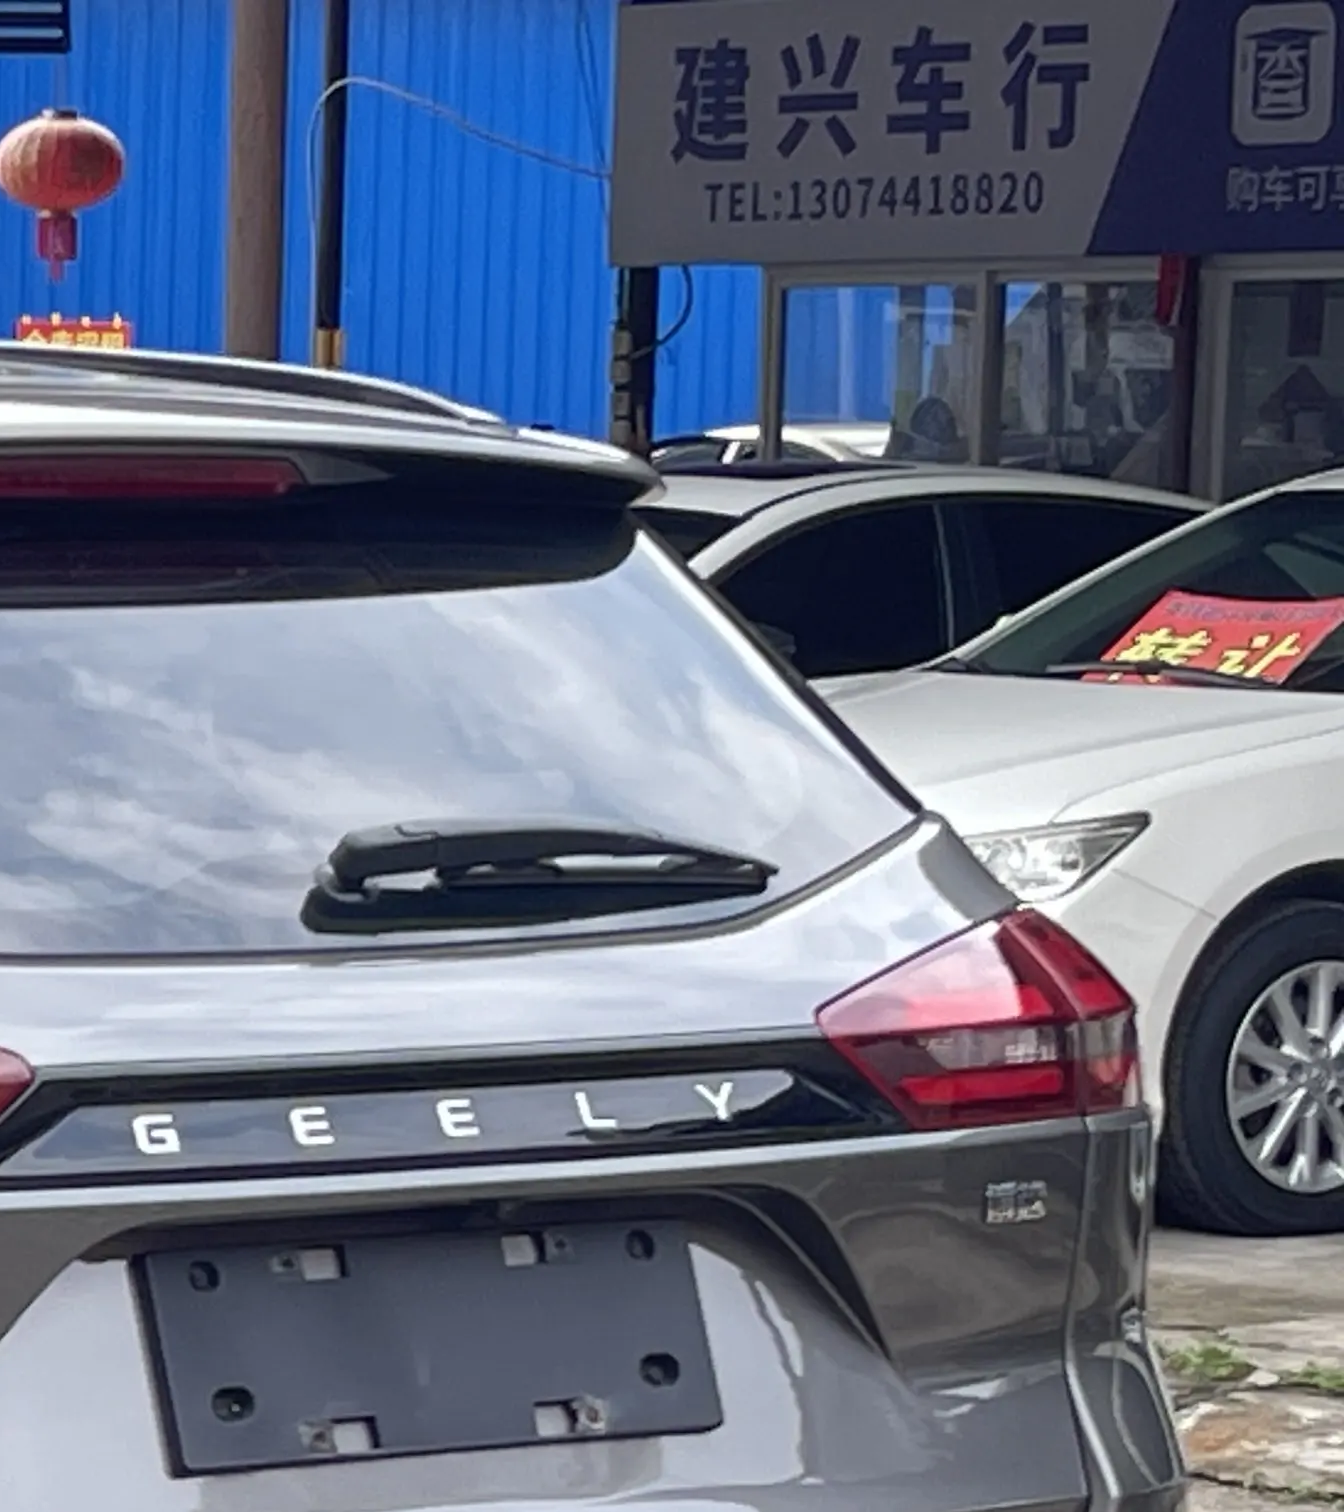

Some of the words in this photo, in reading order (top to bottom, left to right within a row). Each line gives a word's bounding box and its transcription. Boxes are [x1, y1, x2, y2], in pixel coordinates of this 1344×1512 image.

[670, 21, 1090, 165] 建兴车行
[704, 171, 1045, 223] TEL:13074418820
[132, 1081, 735, 1155] GEELY
